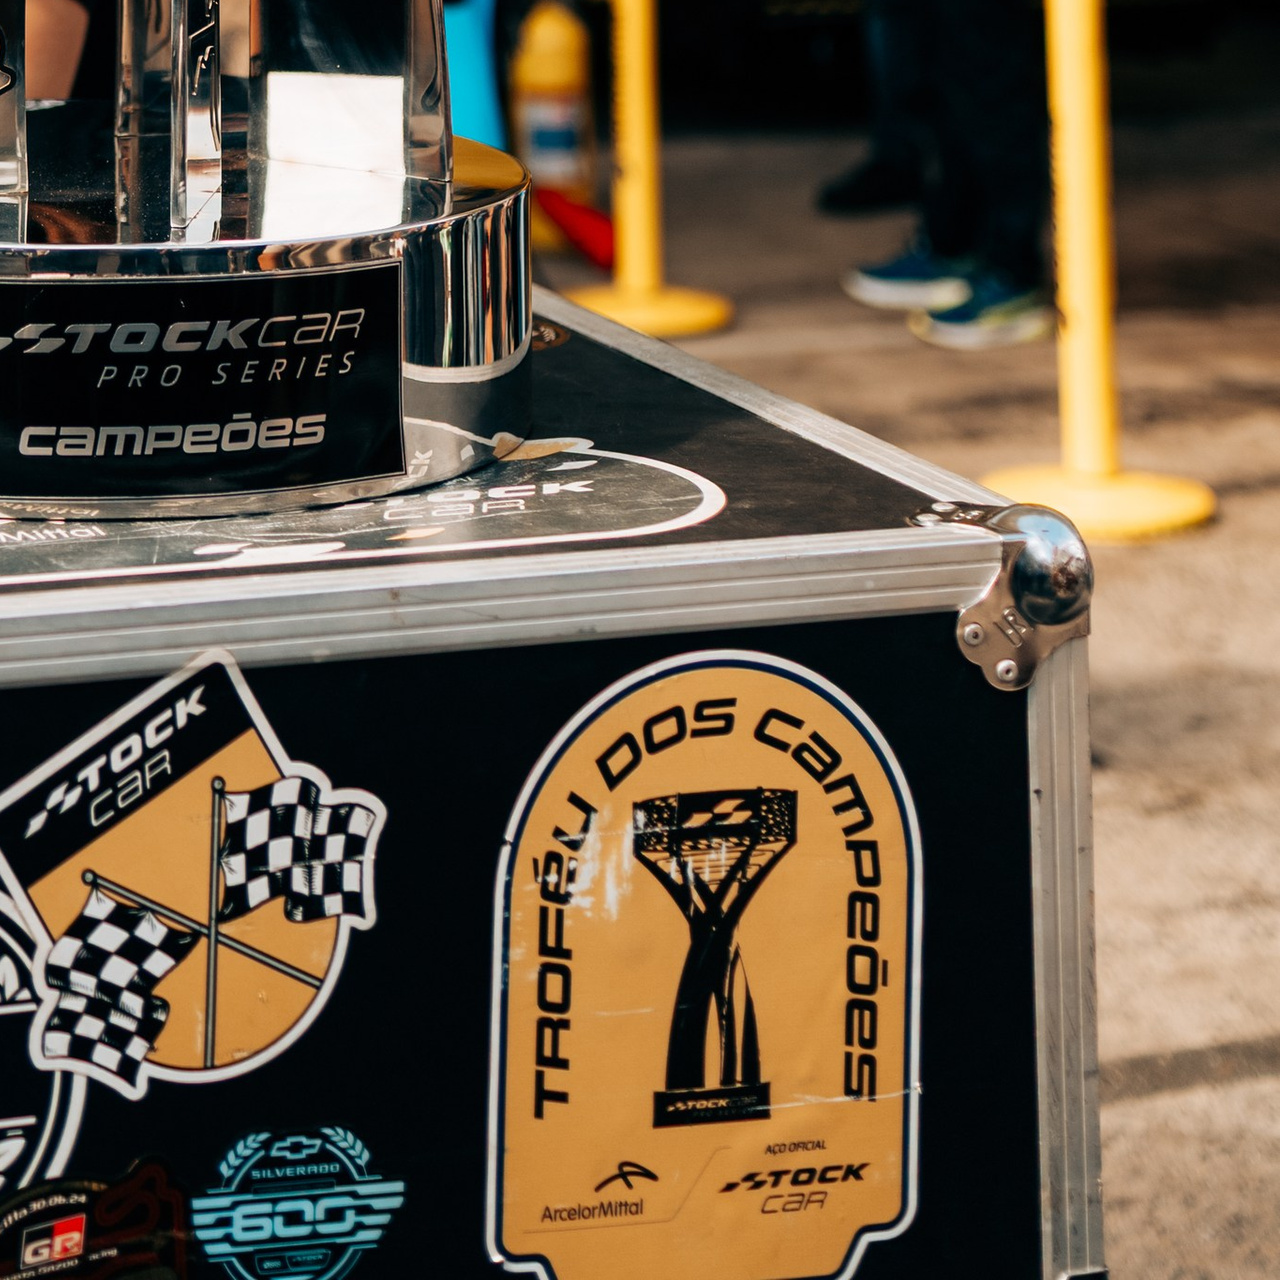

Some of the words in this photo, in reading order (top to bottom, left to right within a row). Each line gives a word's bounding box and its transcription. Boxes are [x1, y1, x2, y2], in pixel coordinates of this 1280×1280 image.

[97, 365, 183, 388] PRO
[212, 351, 356, 386] SERIES
[45, 684, 208, 815] STOCK
[532, 790, 599, 1120] TROFÉU
[595, 697, 738, 792] DOS
[764, 1144, 786, 1157] AÇO
[788, 1140, 828, 1153] OFICIAL
[251, 1161, 341, 1180] SILVERADO
[740, 1162, 871, 1192] STOCK
[232, 1195, 356, 1243] 600
[541, 1198, 644, 1224] ArcelorMittal
[23, 1230, 83, 1266] GR
[88, 1247, 118, 1262] acing
